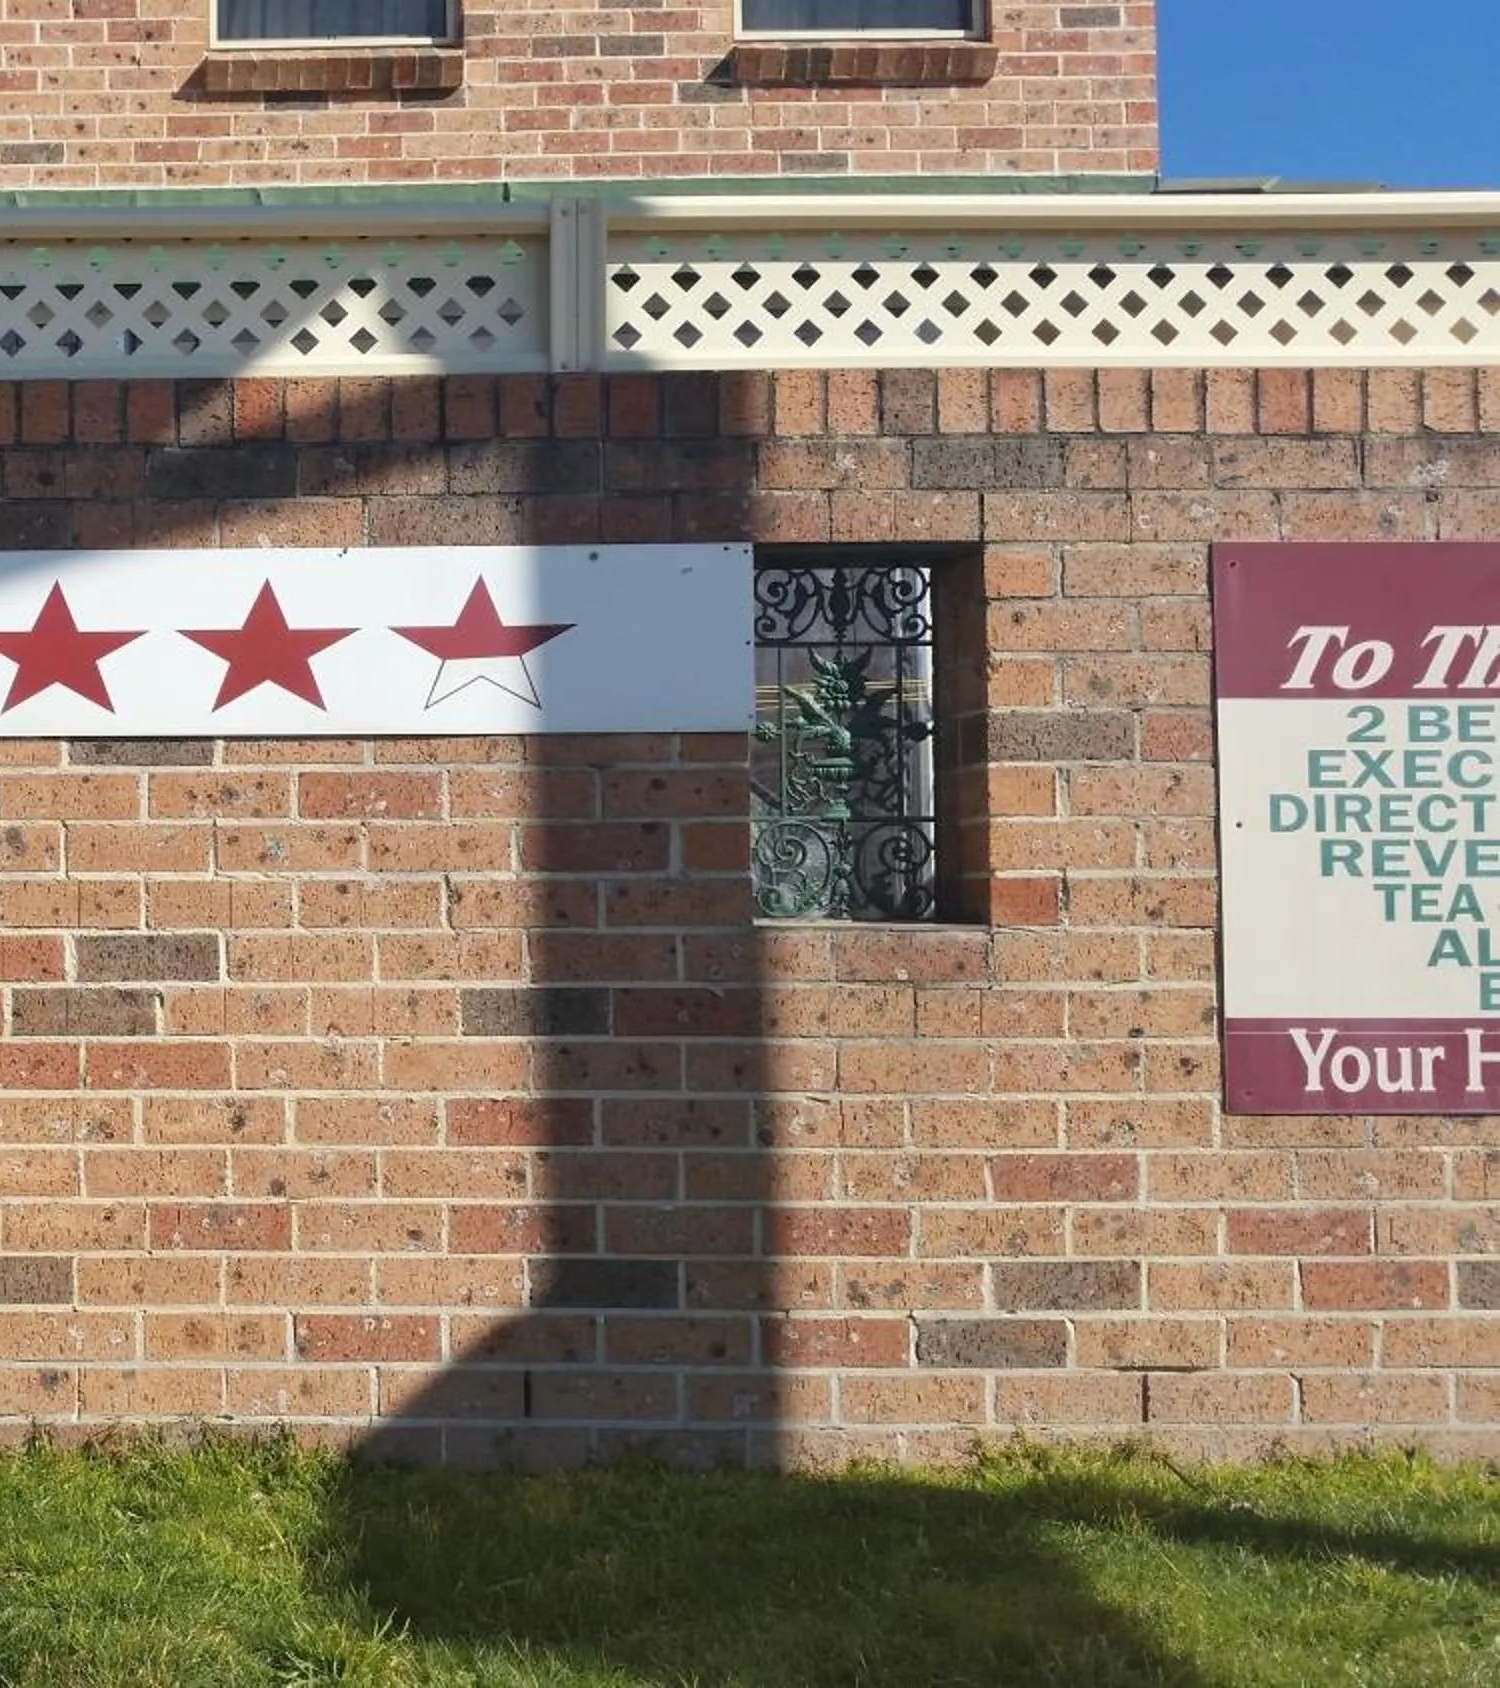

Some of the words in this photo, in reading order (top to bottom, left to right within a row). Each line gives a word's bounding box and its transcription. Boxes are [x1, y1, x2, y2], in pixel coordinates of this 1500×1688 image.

[1280, 624, 1395, 690] To
[1345, 705, 1388, 743] 2
[1408, 704, 1497, 743] BE
[1307, 749, 1494, 789] EXEC
[1269, 793, 1497, 833] DIRECT
[1320, 839, 1500, 878] REVE
[1374, 883, 1485, 922] TEA
[1288, 1027, 1445, 1093] Your
